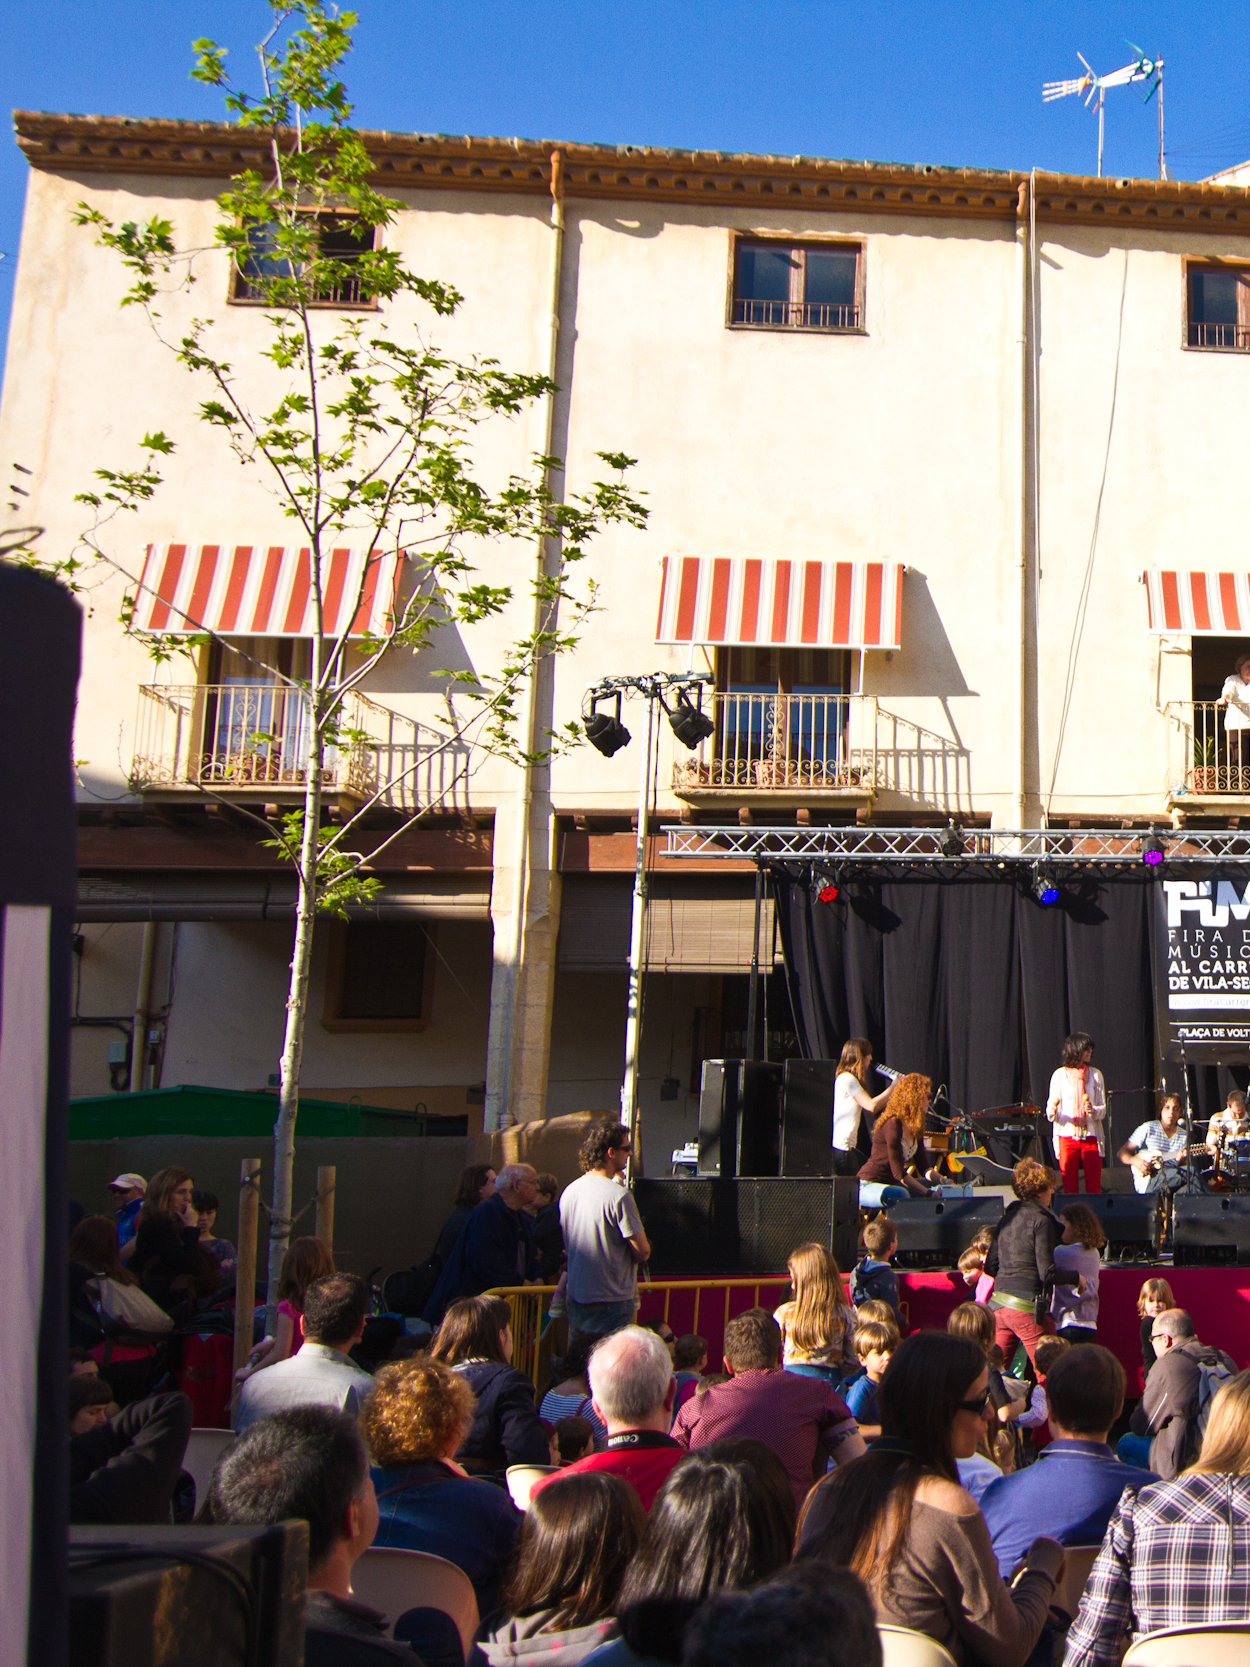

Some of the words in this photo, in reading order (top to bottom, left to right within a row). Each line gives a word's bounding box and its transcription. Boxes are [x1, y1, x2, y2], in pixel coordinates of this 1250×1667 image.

[1168, 930, 1223, 942] FIRA
[1168, 960, 1191, 974] AL
[1168, 976, 1189, 990] DE
[1179, 1027, 1210, 1039] PLAÇA
[1212, 1028, 1225, 1038] DE
[607, 1434, 639, 1447] Canon
